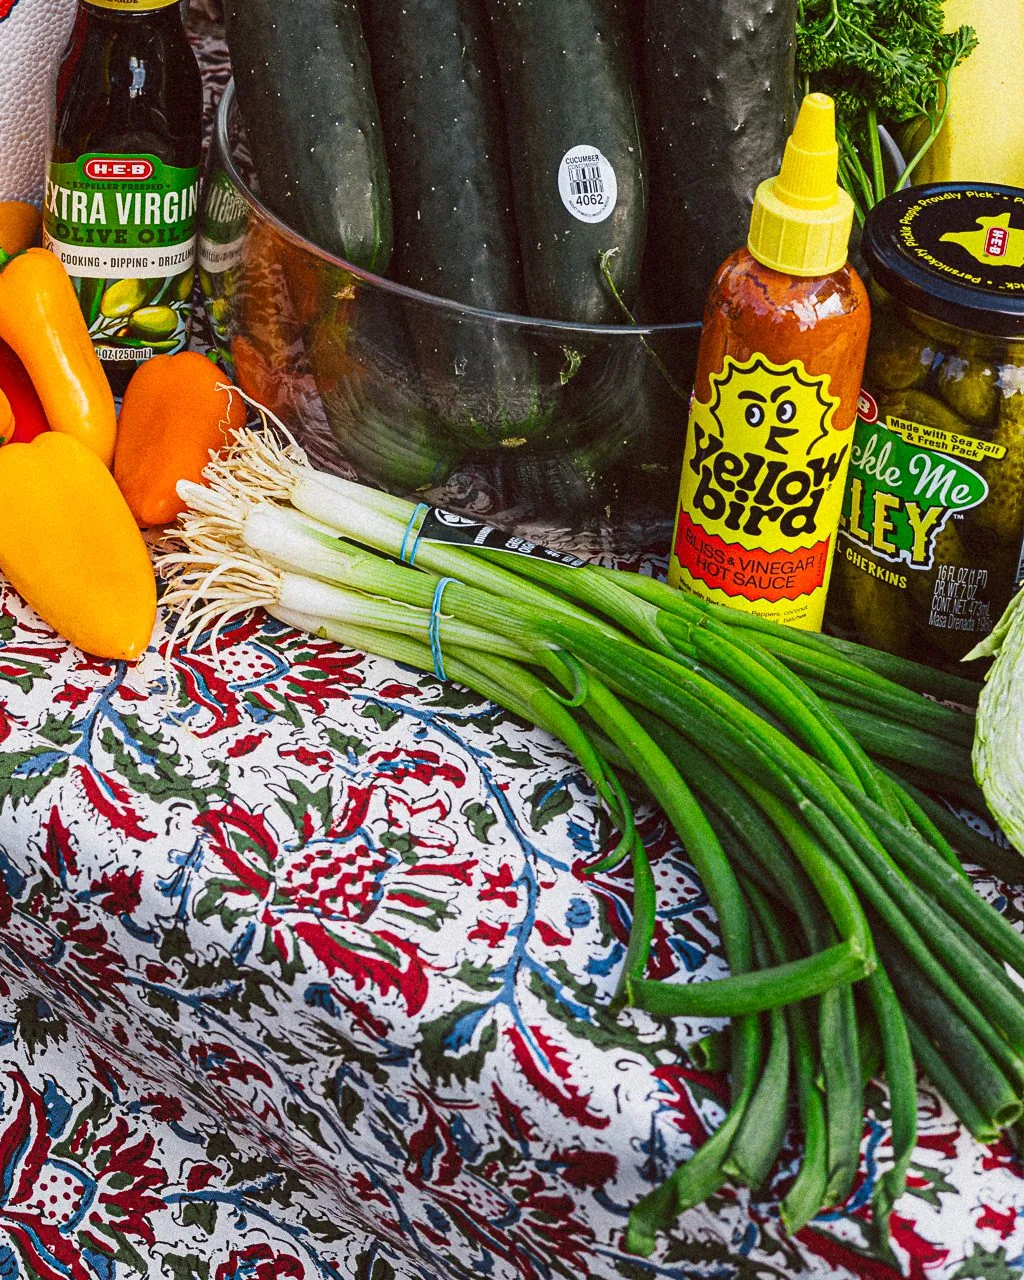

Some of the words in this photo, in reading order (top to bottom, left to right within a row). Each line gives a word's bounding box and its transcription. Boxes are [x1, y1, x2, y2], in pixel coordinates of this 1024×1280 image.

[93, 163, 146, 175] H-E-B
[565, 154, 600, 165] CUCUMBER
[72, 181, 119, 191] EXPELLER
[121, 183, 163, 191] PRESSED
[45, 176, 107, 225] EXTRA
[115, 181, 199, 225] VIRGIN
[576, 193, 604, 207] 4062
[917, 192, 962, 207] Proudly
[899, 204, 923, 225] People
[55, 223, 128, 244] OLIVE
[137, 227, 181, 244] OIL
[899, 225, 919, 248] Pickle
[60, 252, 100, 268] COOKING
[110, 257, 148, 268] DIPPING
[915, 248, 982, 284] Persnickety
[114, 348, 152, 360] (250mL)
[890, 418, 920, 434] Made
[922, 428, 947, 441] with
[950, 434, 973, 448] Sea
[976, 441, 1000, 455] Salt
[906, 432, 914, 442] &
[917, 435, 949, 450] Fresh
[951, 444, 980, 458] Pack
[689, 421, 849, 507] Yellow
[850, 433, 903, 487] ckle
[908, 453, 973, 507] Me
[692, 464, 826, 538] bird
[846, 477, 944, 563] LEY
[685, 527, 725, 565] BLISS
[727, 556, 735, 566] &
[739, 555, 816, 575] VINEGAR
[695, 554, 730, 581] HOT
[732, 572, 797, 590] SAUCE
[846, 547, 908, 589] GHERKINS
[937, 563, 947, 581] 16
[947, 565, 955, 583] FL
[957, 567, 968, 584] OZ
[679, 576, 692, 592] Made
[692, 589, 705, 601] with
[705, 596, 720, 607] Red
[783, 605, 809, 616] coconut
[933, 579, 946, 597] DR.
[966, 584, 978, 600] OZ
[931, 595, 951, 613] CONT.
[928, 610, 947, 628] Masa
[947, 614, 975, 632] Drenada
